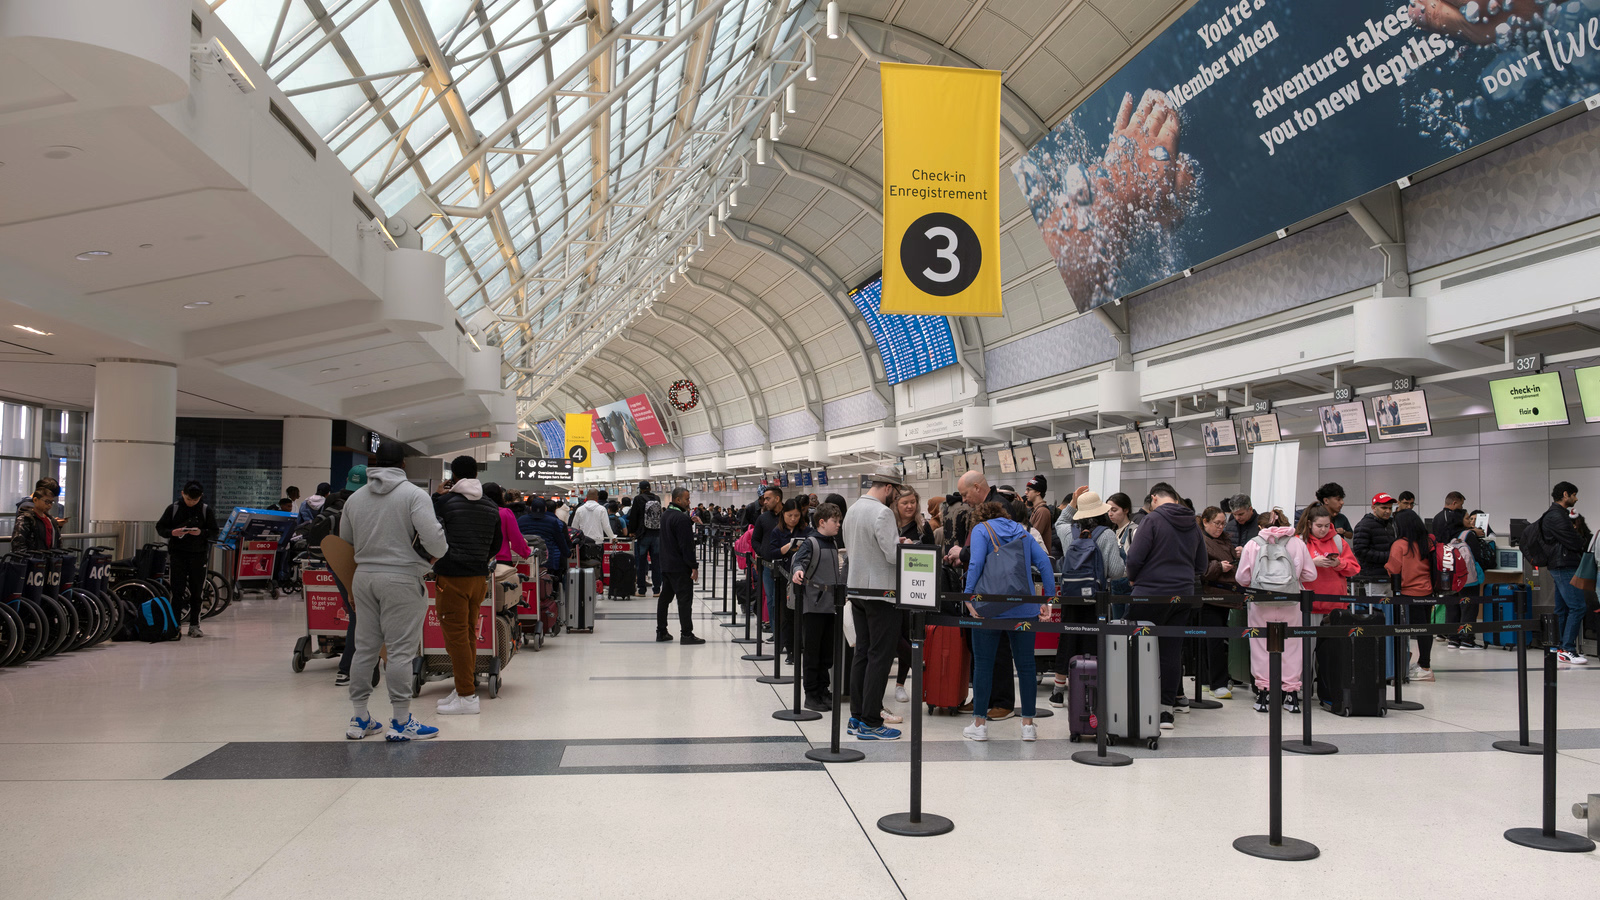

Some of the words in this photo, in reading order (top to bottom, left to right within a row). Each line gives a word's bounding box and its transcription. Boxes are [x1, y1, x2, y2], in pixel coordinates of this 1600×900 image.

[1196, 0, 1252, 49] You're
[1166, 55, 1230, 109] Member
[1227, 20, 1279, 66] when
[1252, 46, 1349, 119] adventure
[1346, 4, 1413, 59] takes
[1482, 50, 1542, 94] DON'T
[1259, 118, 1298, 156] you
[1293, 107, 1318, 131] to
[1315, 80, 1361, 121] new
[1361, 32, 1455, 94] depths.
[911, 168, 966, 183] Check-in
[889, 185, 988, 200] Enregistrement
[922, 226, 961, 283] 3
[1516, 356, 1536, 371] 337
[1394, 378, 1409, 390] 338
[1509, 384, 1541, 396] check-in
[1335, 388, 1349, 400] 339
[1255, 401, 1267, 412] 340
[1519, 407, 1532, 415] flair
[572, 447, 583, 461] 4
[315, 574, 333, 582] CIBC
[911, 579, 926, 587] EXIT
[909, 591, 927, 600] ONLY
